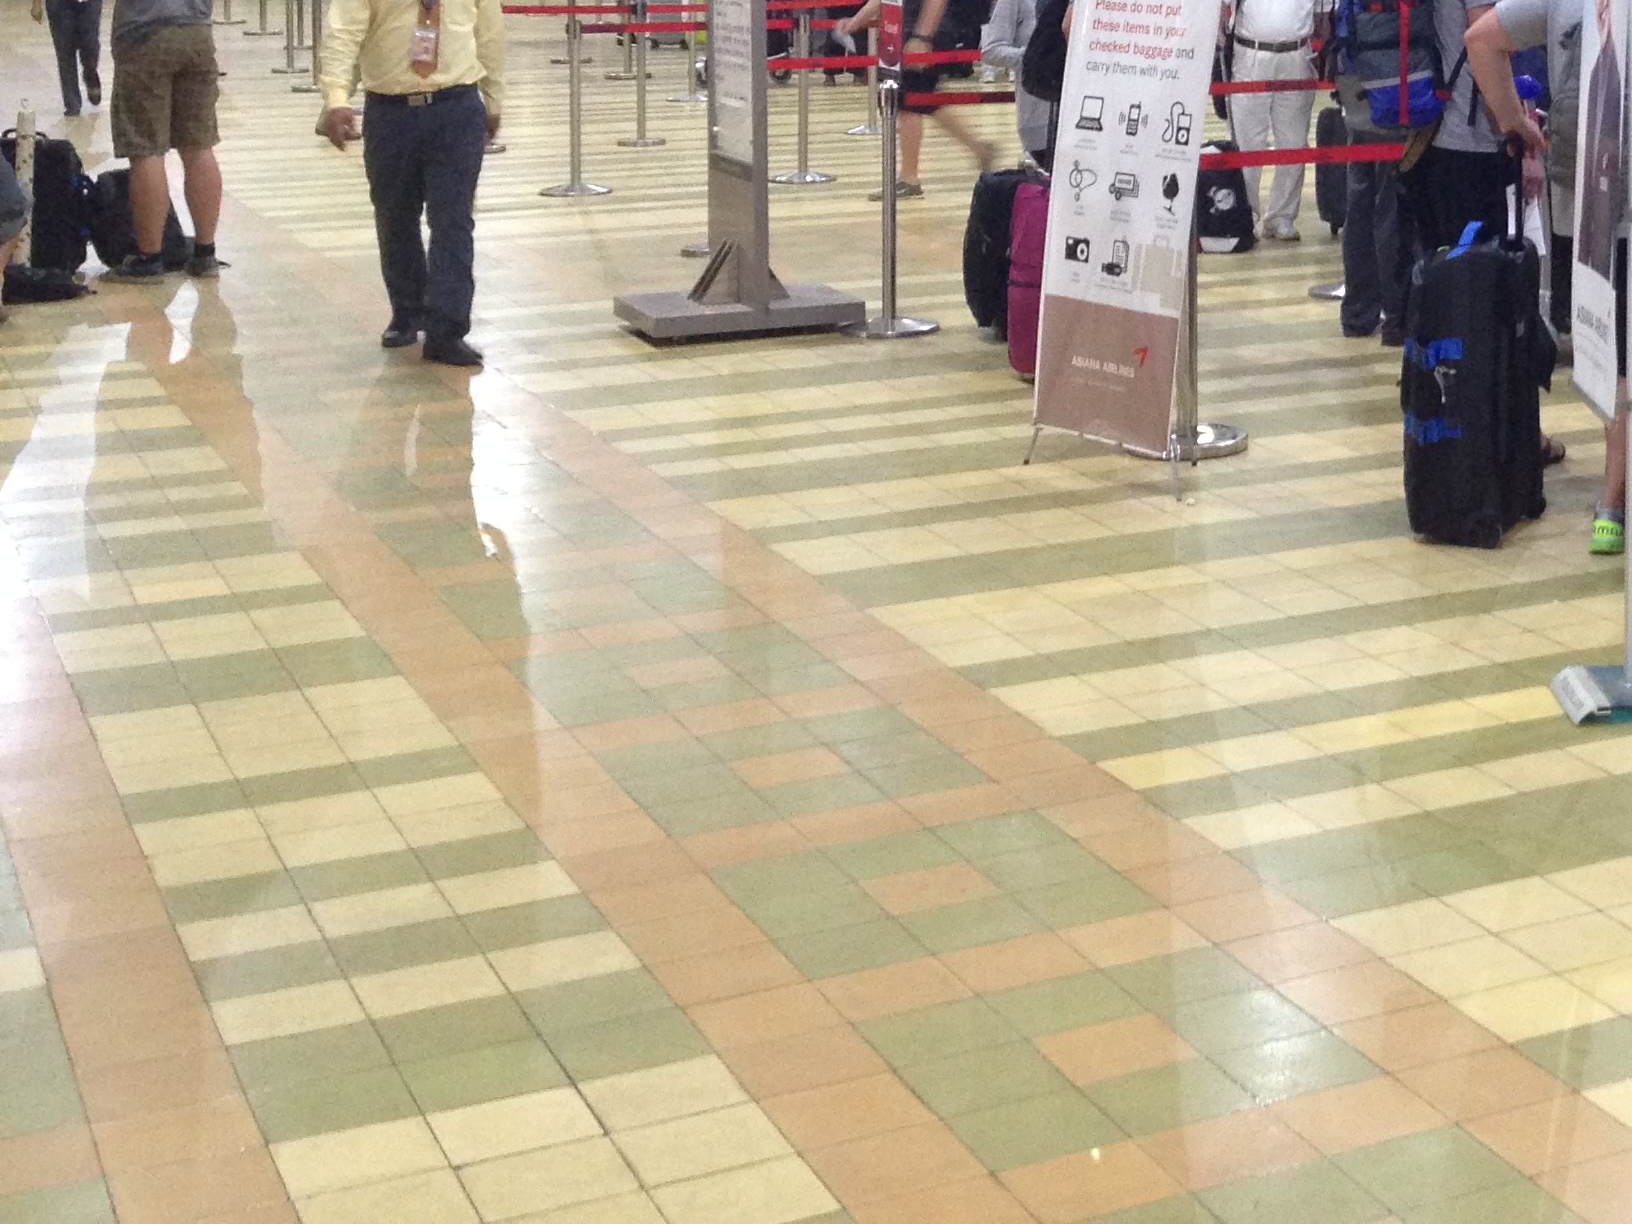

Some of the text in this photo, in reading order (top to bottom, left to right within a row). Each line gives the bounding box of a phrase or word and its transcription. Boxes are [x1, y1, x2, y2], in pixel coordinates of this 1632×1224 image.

[1130, 0, 1143, 13] do
[1146, 2, 1163, 15] not
[1165, 4, 1182, 18] put
[1092, 19, 1186, 39] these items in your
[1089, 38, 1195, 60] checked baggage and
[1086, 60, 1181, 81] carry them with you.
